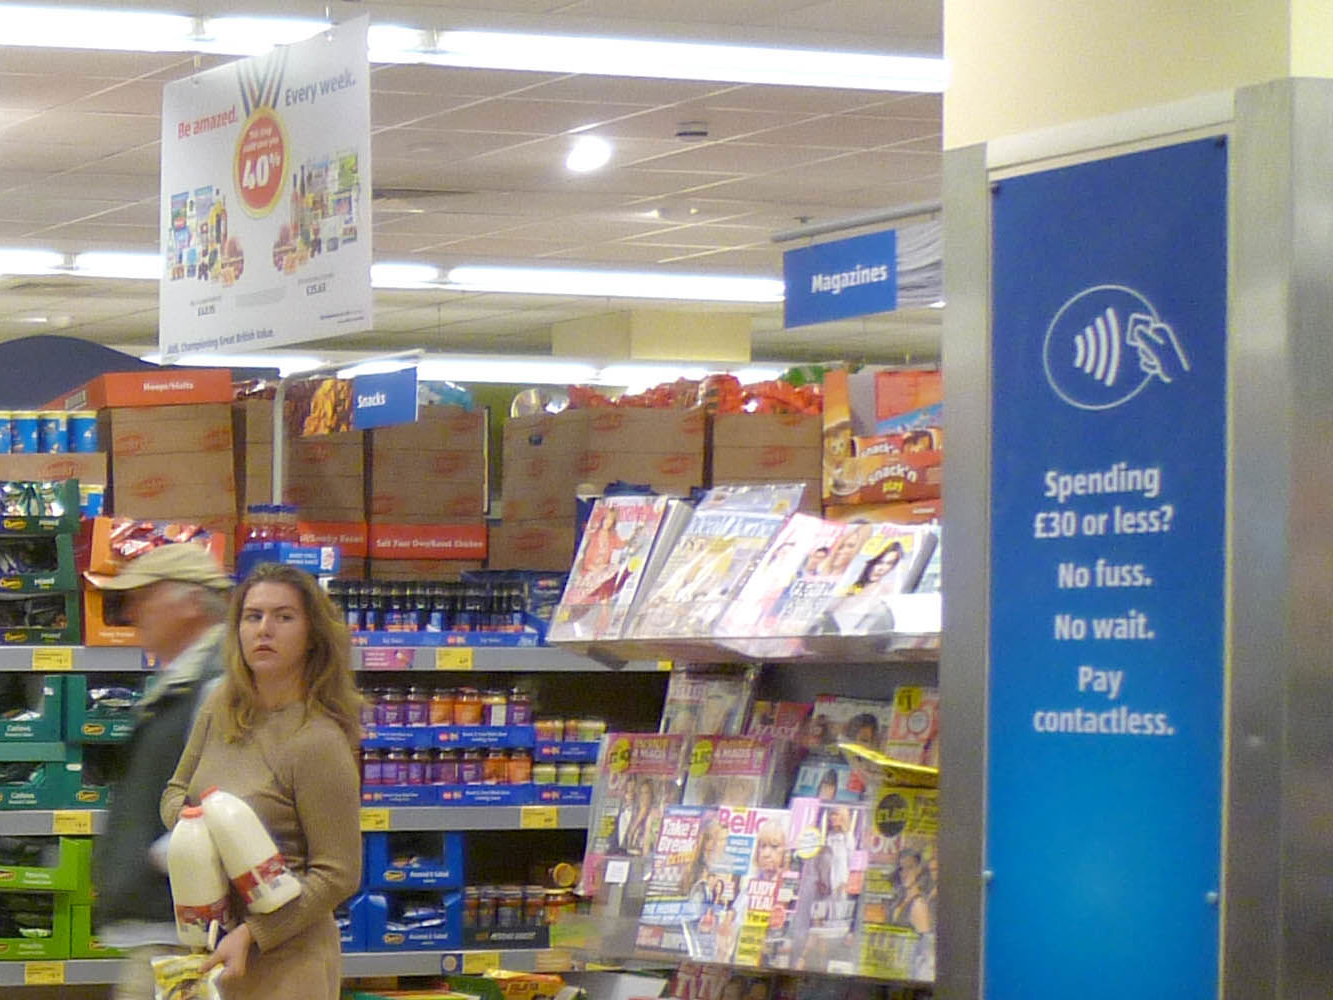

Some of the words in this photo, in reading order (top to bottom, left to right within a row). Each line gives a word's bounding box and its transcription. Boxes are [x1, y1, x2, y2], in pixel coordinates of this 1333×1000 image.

[285, 82, 317, 107] Every
[319, 67, 357, 95] week.
[177, 122, 191, 140] Be
[193, 104, 238, 135] amazed.
[242, 151, 282, 190] 40%
[811, 264, 888, 295] Magazines
[357, 392, 386, 408] Snacks
[1044, 462, 1161, 502] Spending
[1033, 510, 1077, 539] £30
[1082, 514, 1109, 536] or
[1113, 504, 1174, 535] less?
[1058, 562, 1090, 589] No
[1095, 557, 1153, 588] fuss.
[1054, 613, 1086, 641] No
[1092, 608, 1156, 640] wait.
[1077, 665, 1123, 700] Pay
[1033, 705, 1176, 736] contactless.
